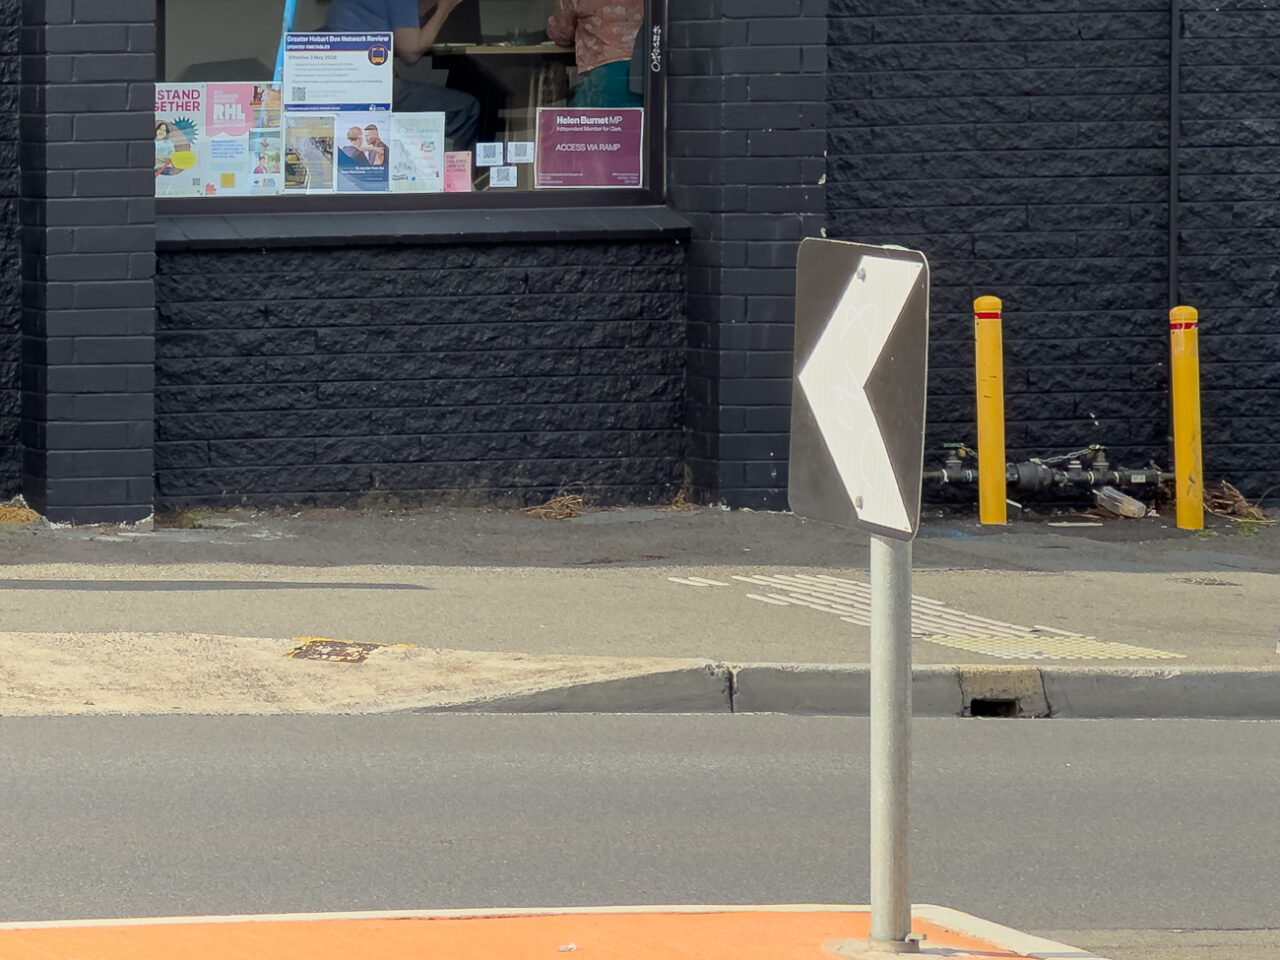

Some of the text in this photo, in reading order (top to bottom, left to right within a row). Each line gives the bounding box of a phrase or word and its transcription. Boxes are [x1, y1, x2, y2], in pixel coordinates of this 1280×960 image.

[157, 89, 201, 100] STAND
[213, 103, 246, 120] RHL
[556, 116, 623, 124] Helen Burnet MP
[555, 143, 621, 152] ACCESS VIA RAMP
